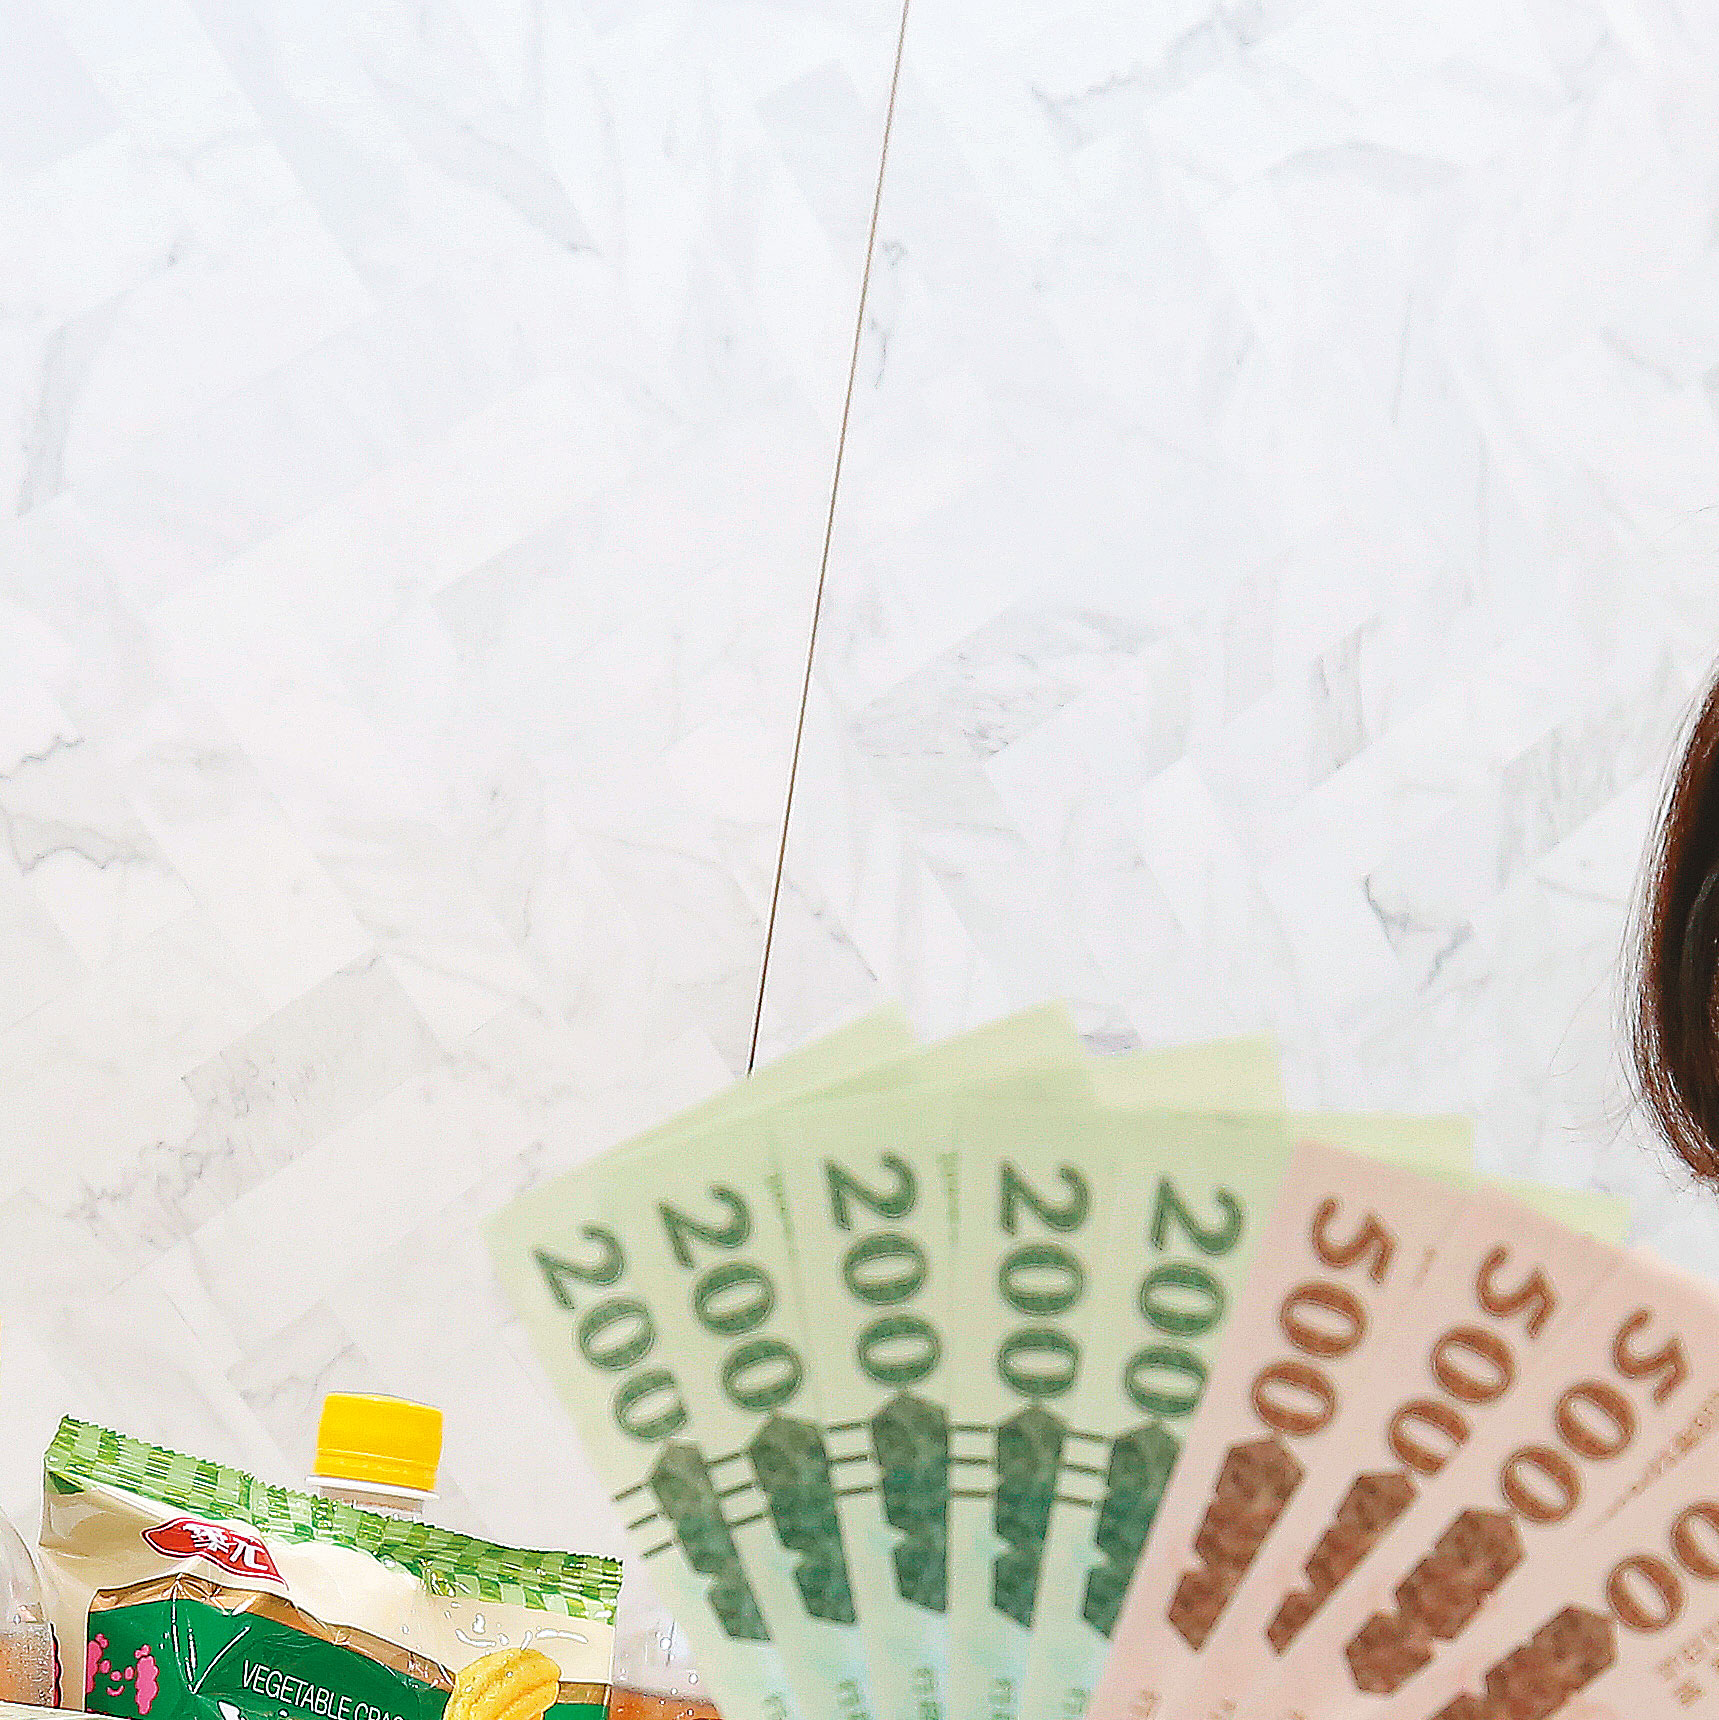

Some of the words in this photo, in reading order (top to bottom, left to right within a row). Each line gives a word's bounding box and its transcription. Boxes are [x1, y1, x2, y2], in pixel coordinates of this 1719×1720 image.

[532, 1223, 687, 1441] 200
[656, 1184, 804, 1411] 200
[823, 1150, 942, 1384] 200
[997, 1161, 1091, 1399] 200
[1123, 1176, 1243, 1418] 200
[1251, 1197, 1396, 1437] 500
[1389, 1246, 1557, 1475] 500
[1500, 1309, 1688, 1523] 500
[182, 1524, 268, 1571] 華元
